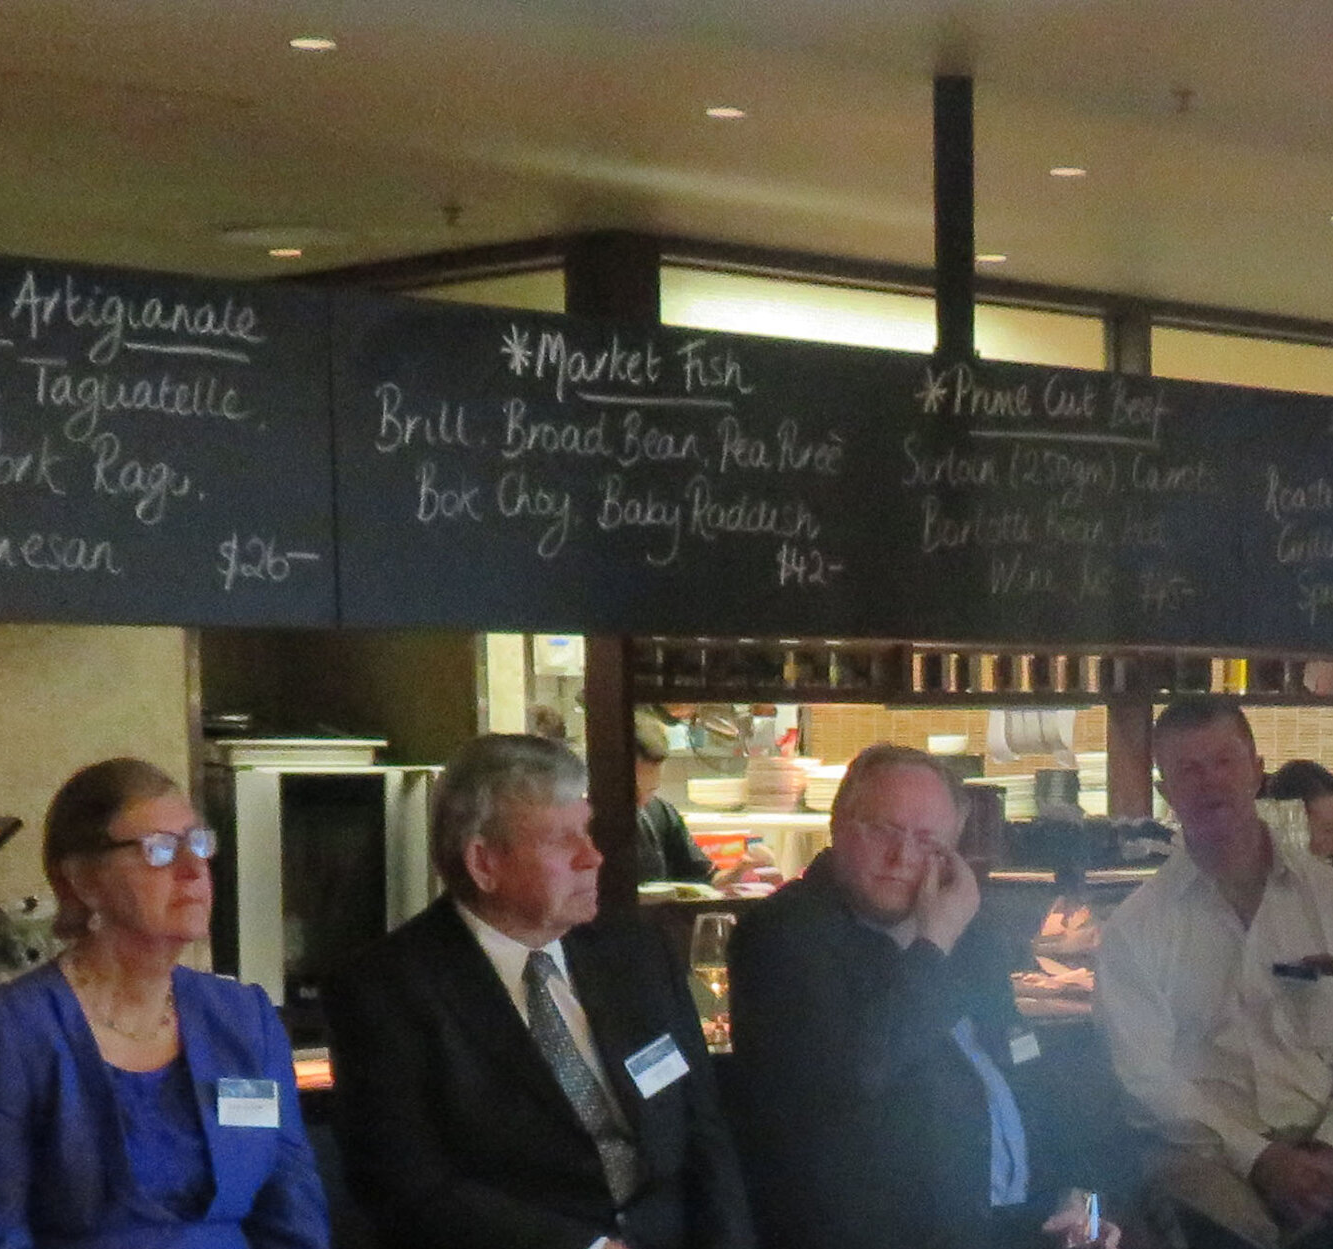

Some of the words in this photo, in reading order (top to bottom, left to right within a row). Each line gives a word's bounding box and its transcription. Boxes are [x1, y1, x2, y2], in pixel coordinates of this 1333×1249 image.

[536, 329, 662, 402] Market
[677, 338, 754, 395] Fish
[502, 397, 613, 459] Broad
[717, 414, 772, 473] Pea
[951, 363, 1033, 417] Prime
[1042, 373, 1096, 418] Cut
[1109, 377, 1167, 446] Beef
[901, 431, 999, 488] Sirloin
[596, 473, 681, 567] Baby
